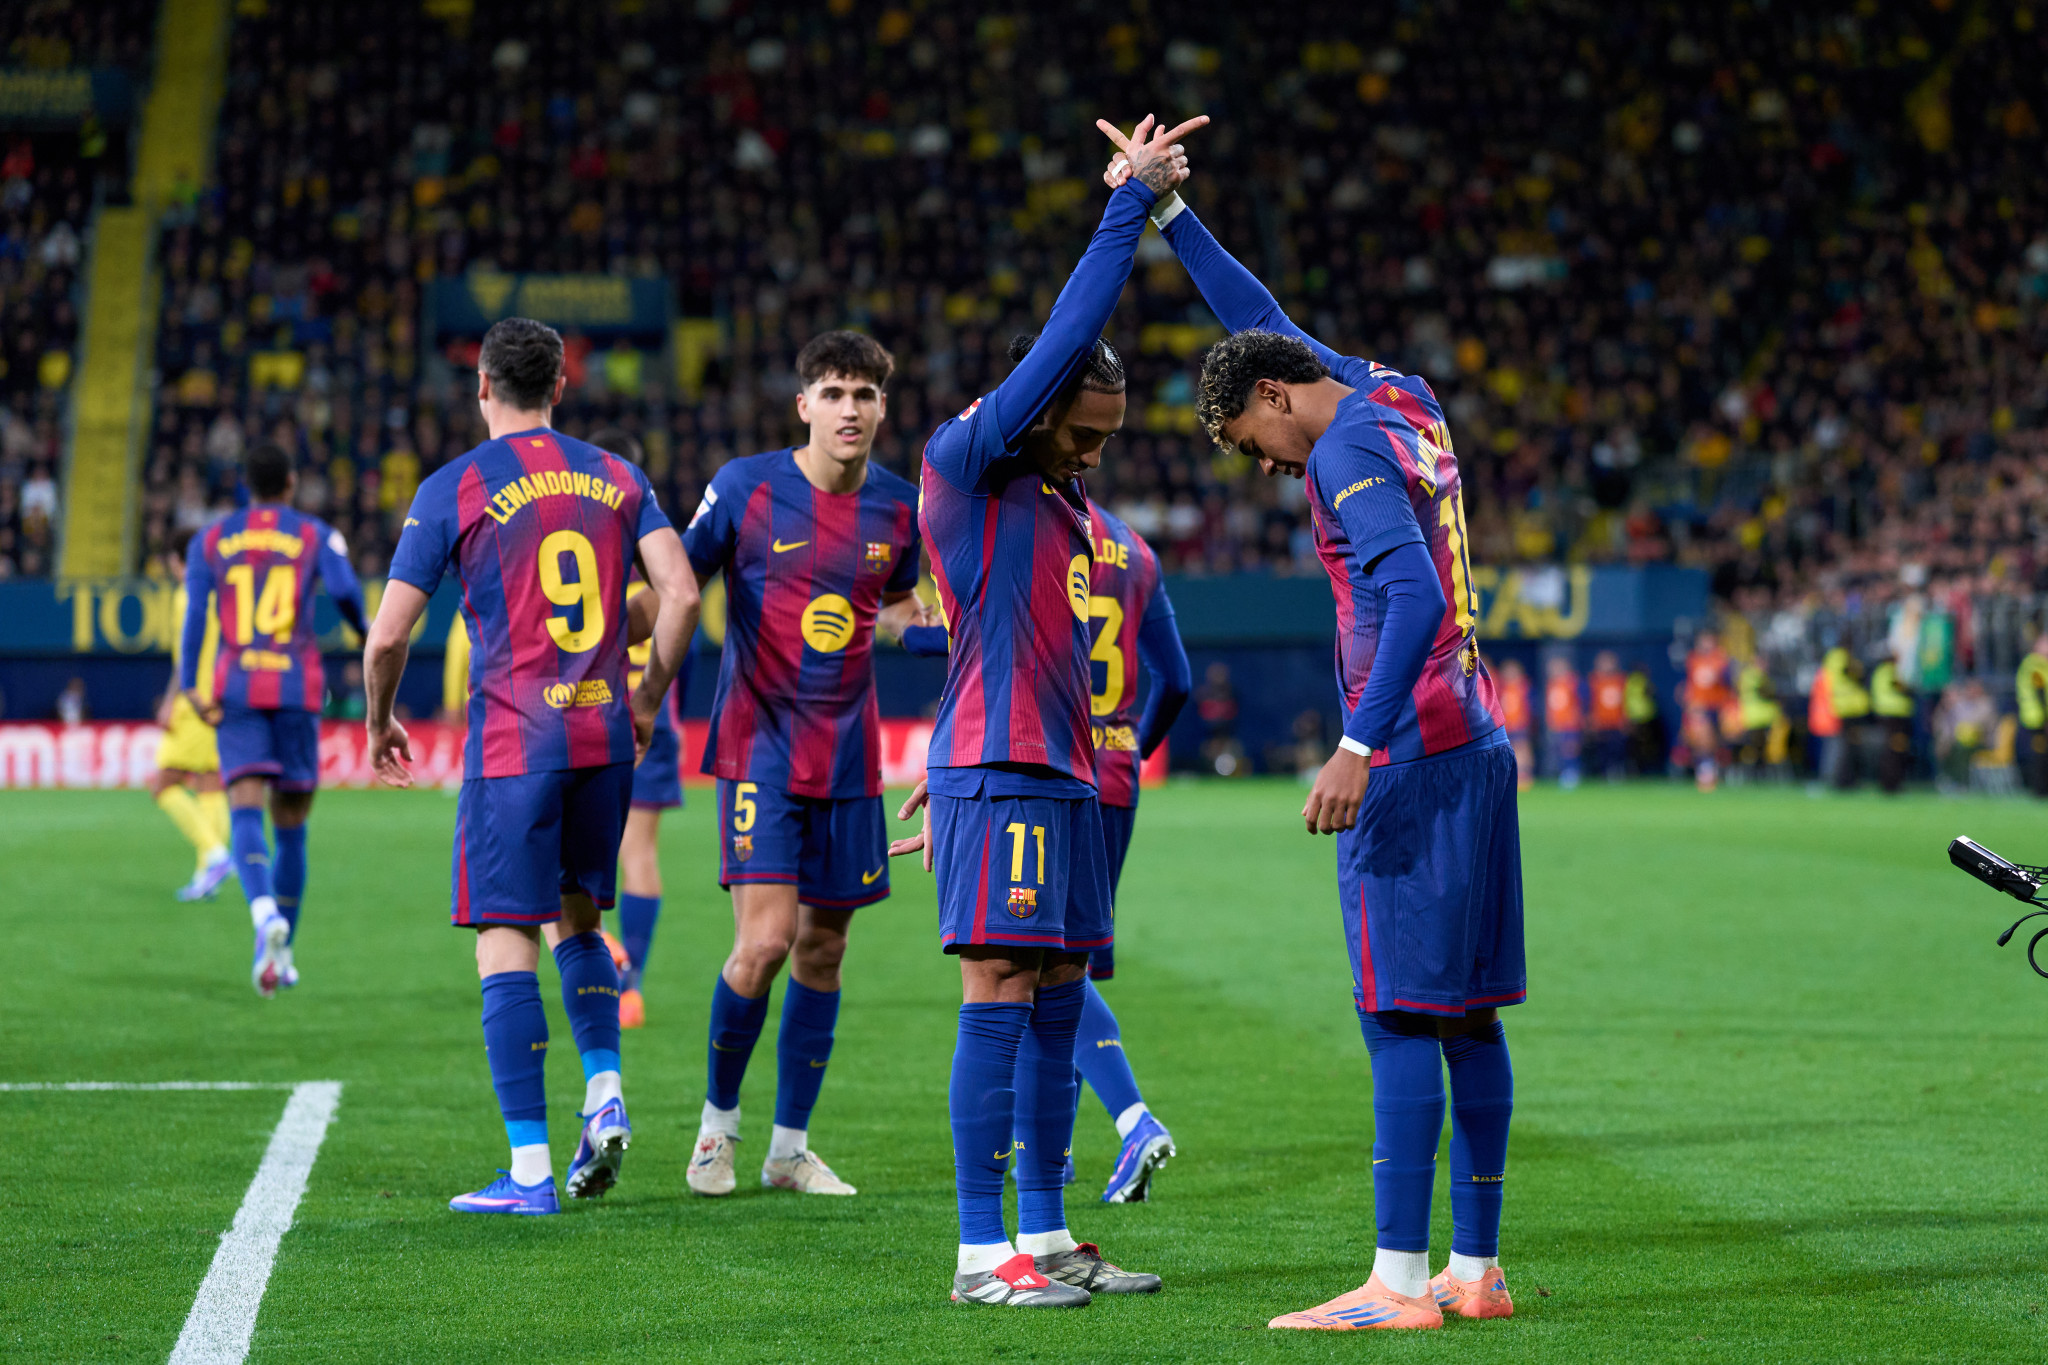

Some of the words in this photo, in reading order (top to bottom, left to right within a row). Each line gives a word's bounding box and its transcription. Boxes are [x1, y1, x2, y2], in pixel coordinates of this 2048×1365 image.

[484, 471, 625, 525] LEWANDOWSKI
[226, 564, 296, 645] 14
[538, 529, 605, 653] 9
[1088, 596, 1124, 716] 3
[734, 782, 758, 832] 5
[1006, 822, 1045, 884] 11
